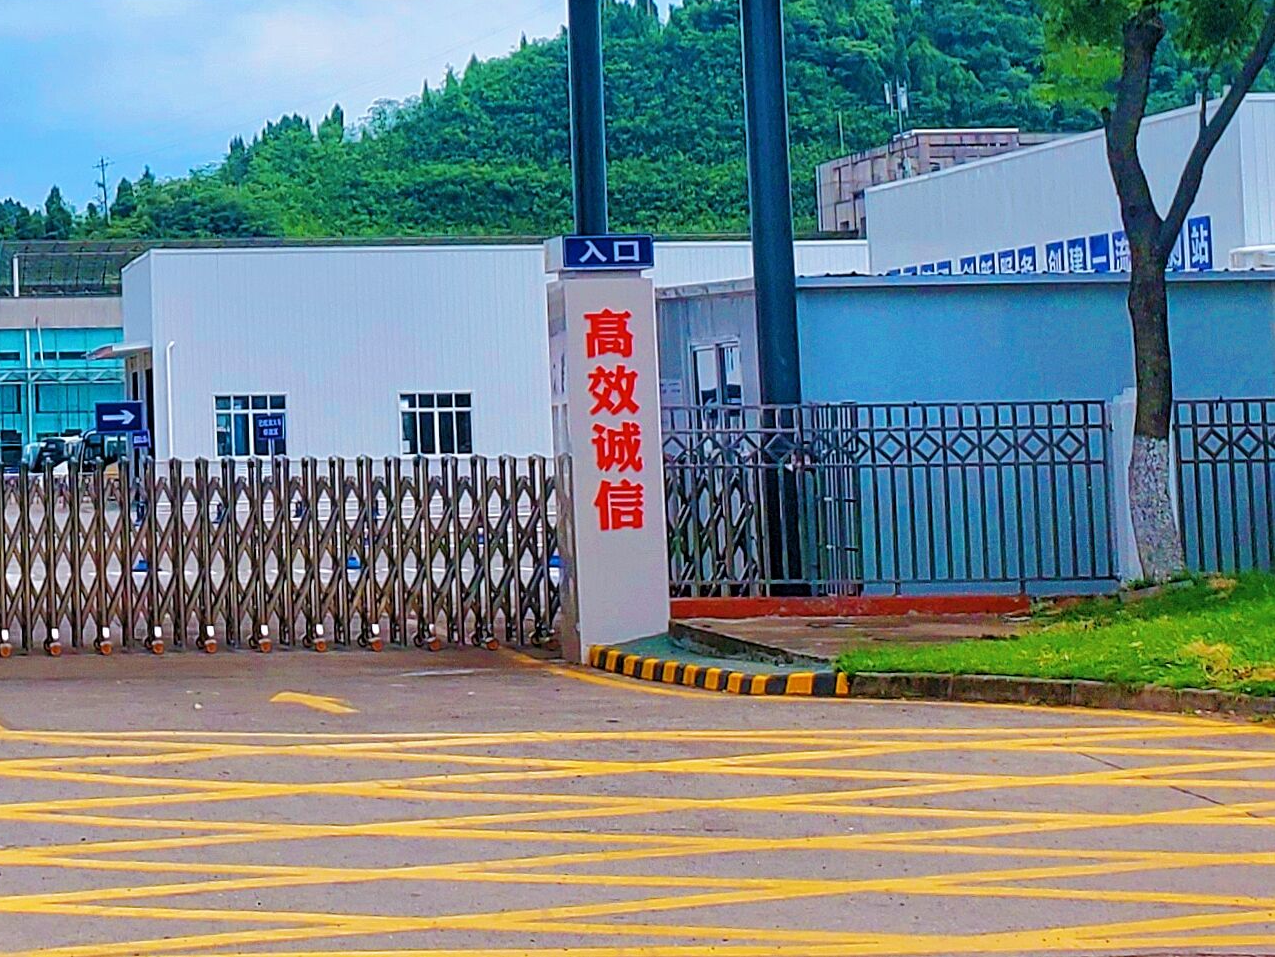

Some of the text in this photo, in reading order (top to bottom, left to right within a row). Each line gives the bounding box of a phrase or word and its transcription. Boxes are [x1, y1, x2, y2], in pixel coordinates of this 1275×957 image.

[579, 241, 640, 262] 入口
[584, 309, 644, 531] 高效诚信
